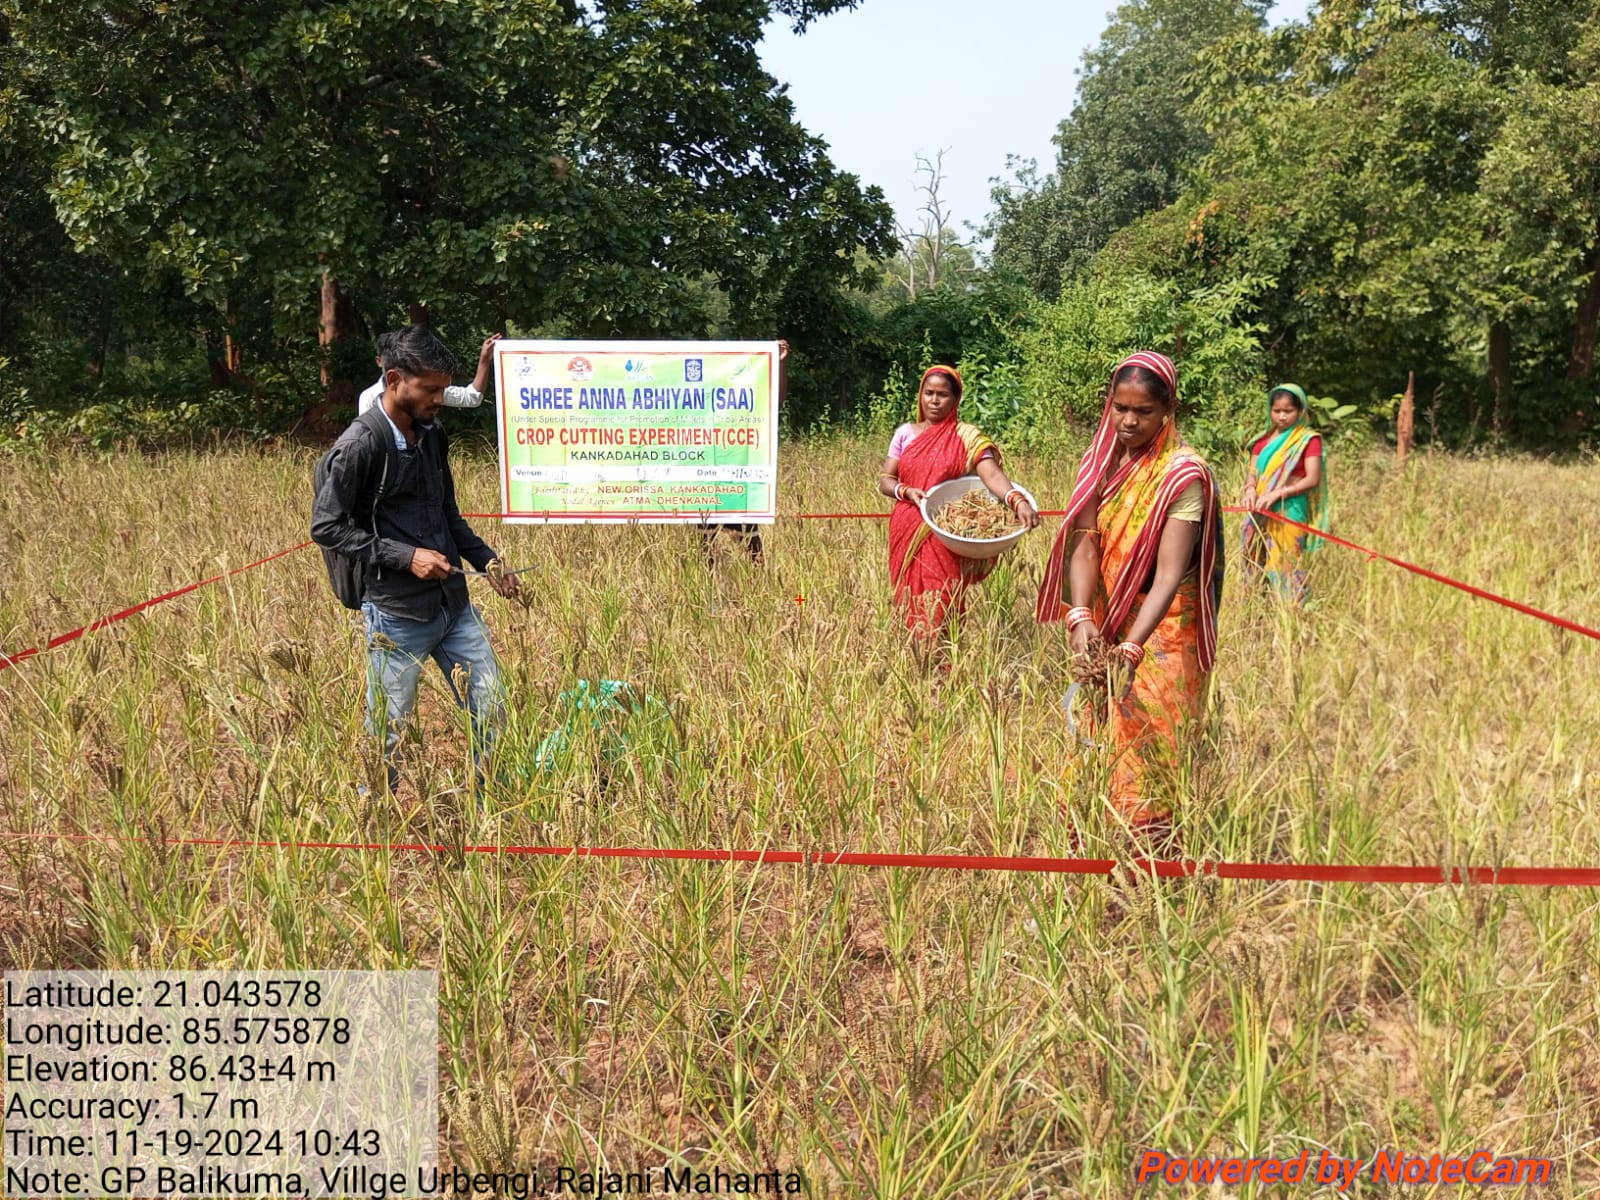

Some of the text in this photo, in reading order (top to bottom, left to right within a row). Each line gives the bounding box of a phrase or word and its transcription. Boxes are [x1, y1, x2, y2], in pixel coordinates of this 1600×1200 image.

[520, 387, 754, 413] SHREE ANNA ABHIYAN (SAA)
[516, 428, 555, 445] CROP
[559, 428, 625, 445] CUTTING
[570, 451, 705, 460] KANKADAHAD BLOCK
[597, 486, 621, 494] NEW
[670, 486, 744, 494] KANKADAHAD
[657, 497, 722, 505] DHENKANAL
